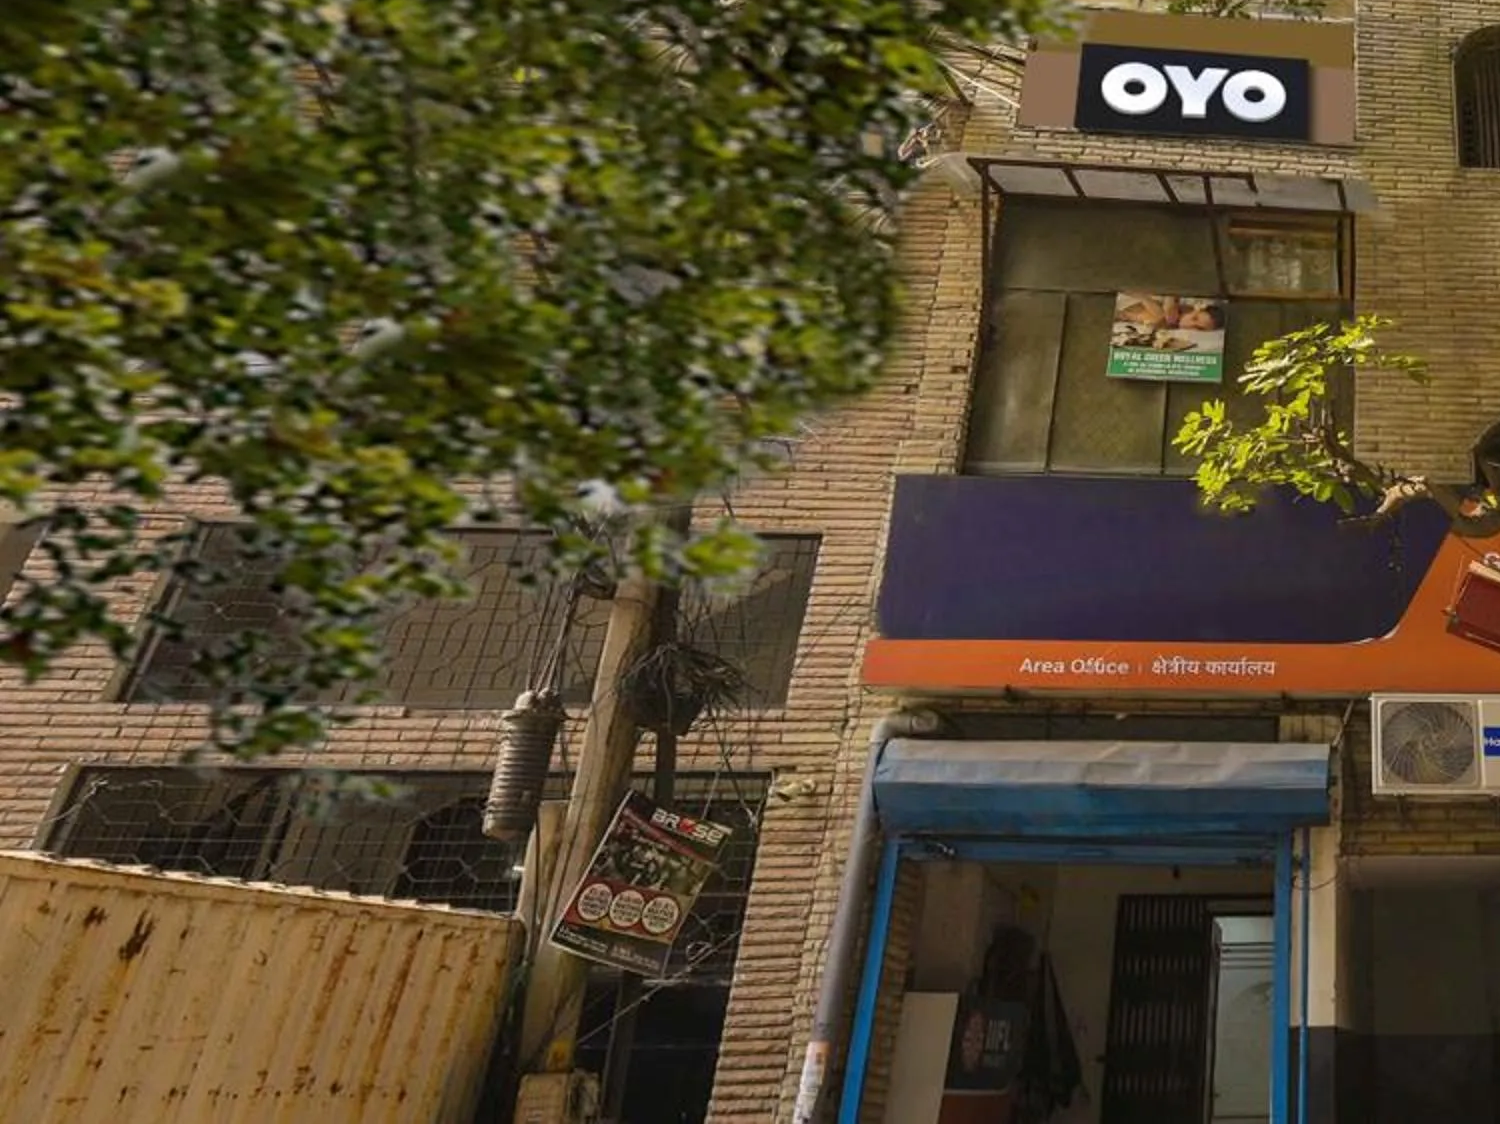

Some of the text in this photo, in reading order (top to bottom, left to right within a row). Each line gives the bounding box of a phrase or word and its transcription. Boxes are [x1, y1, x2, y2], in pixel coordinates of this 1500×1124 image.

[1101, 62, 1287, 123] OYO
[1019, 657, 1130, 675] Area Office
[1204, 656, 1275, 676] कार्यालय
